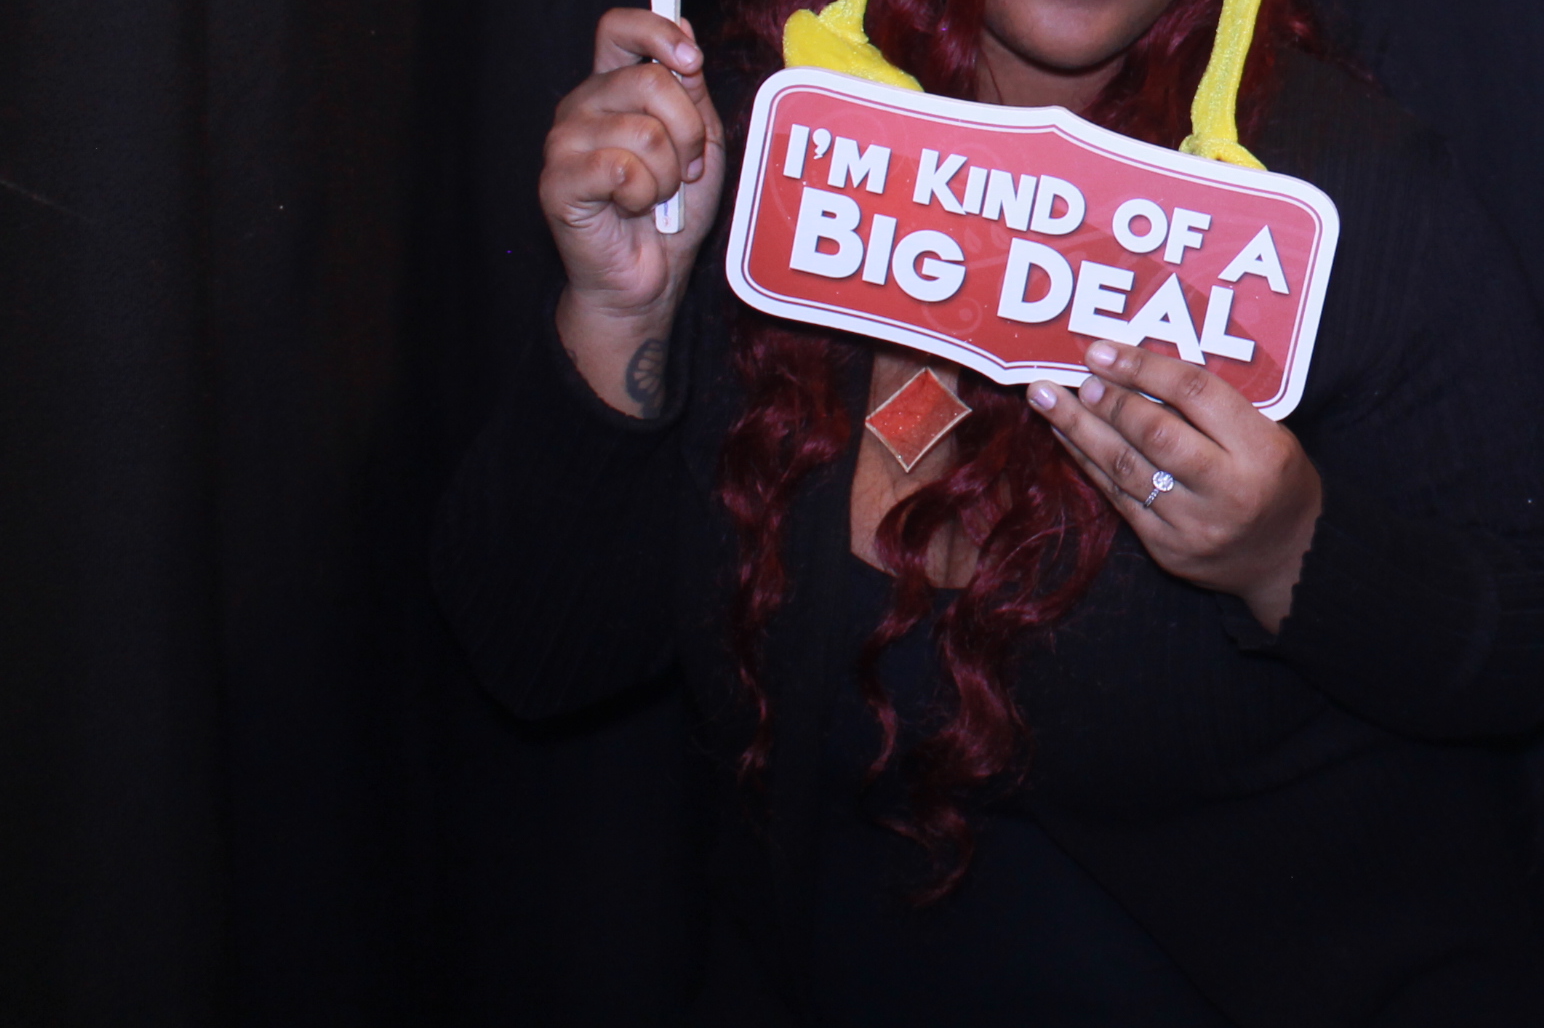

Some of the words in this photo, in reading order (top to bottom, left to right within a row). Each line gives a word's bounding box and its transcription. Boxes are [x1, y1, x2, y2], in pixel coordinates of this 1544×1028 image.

[783, 123, 891, 194] I'M
[912, 148, 1086, 235] KIND
[1112, 198, 1212, 265] OF
[1217, 224, 1290, 295] A
[788, 186, 966, 302] BIG
[997, 237, 1256, 365] DEAL
